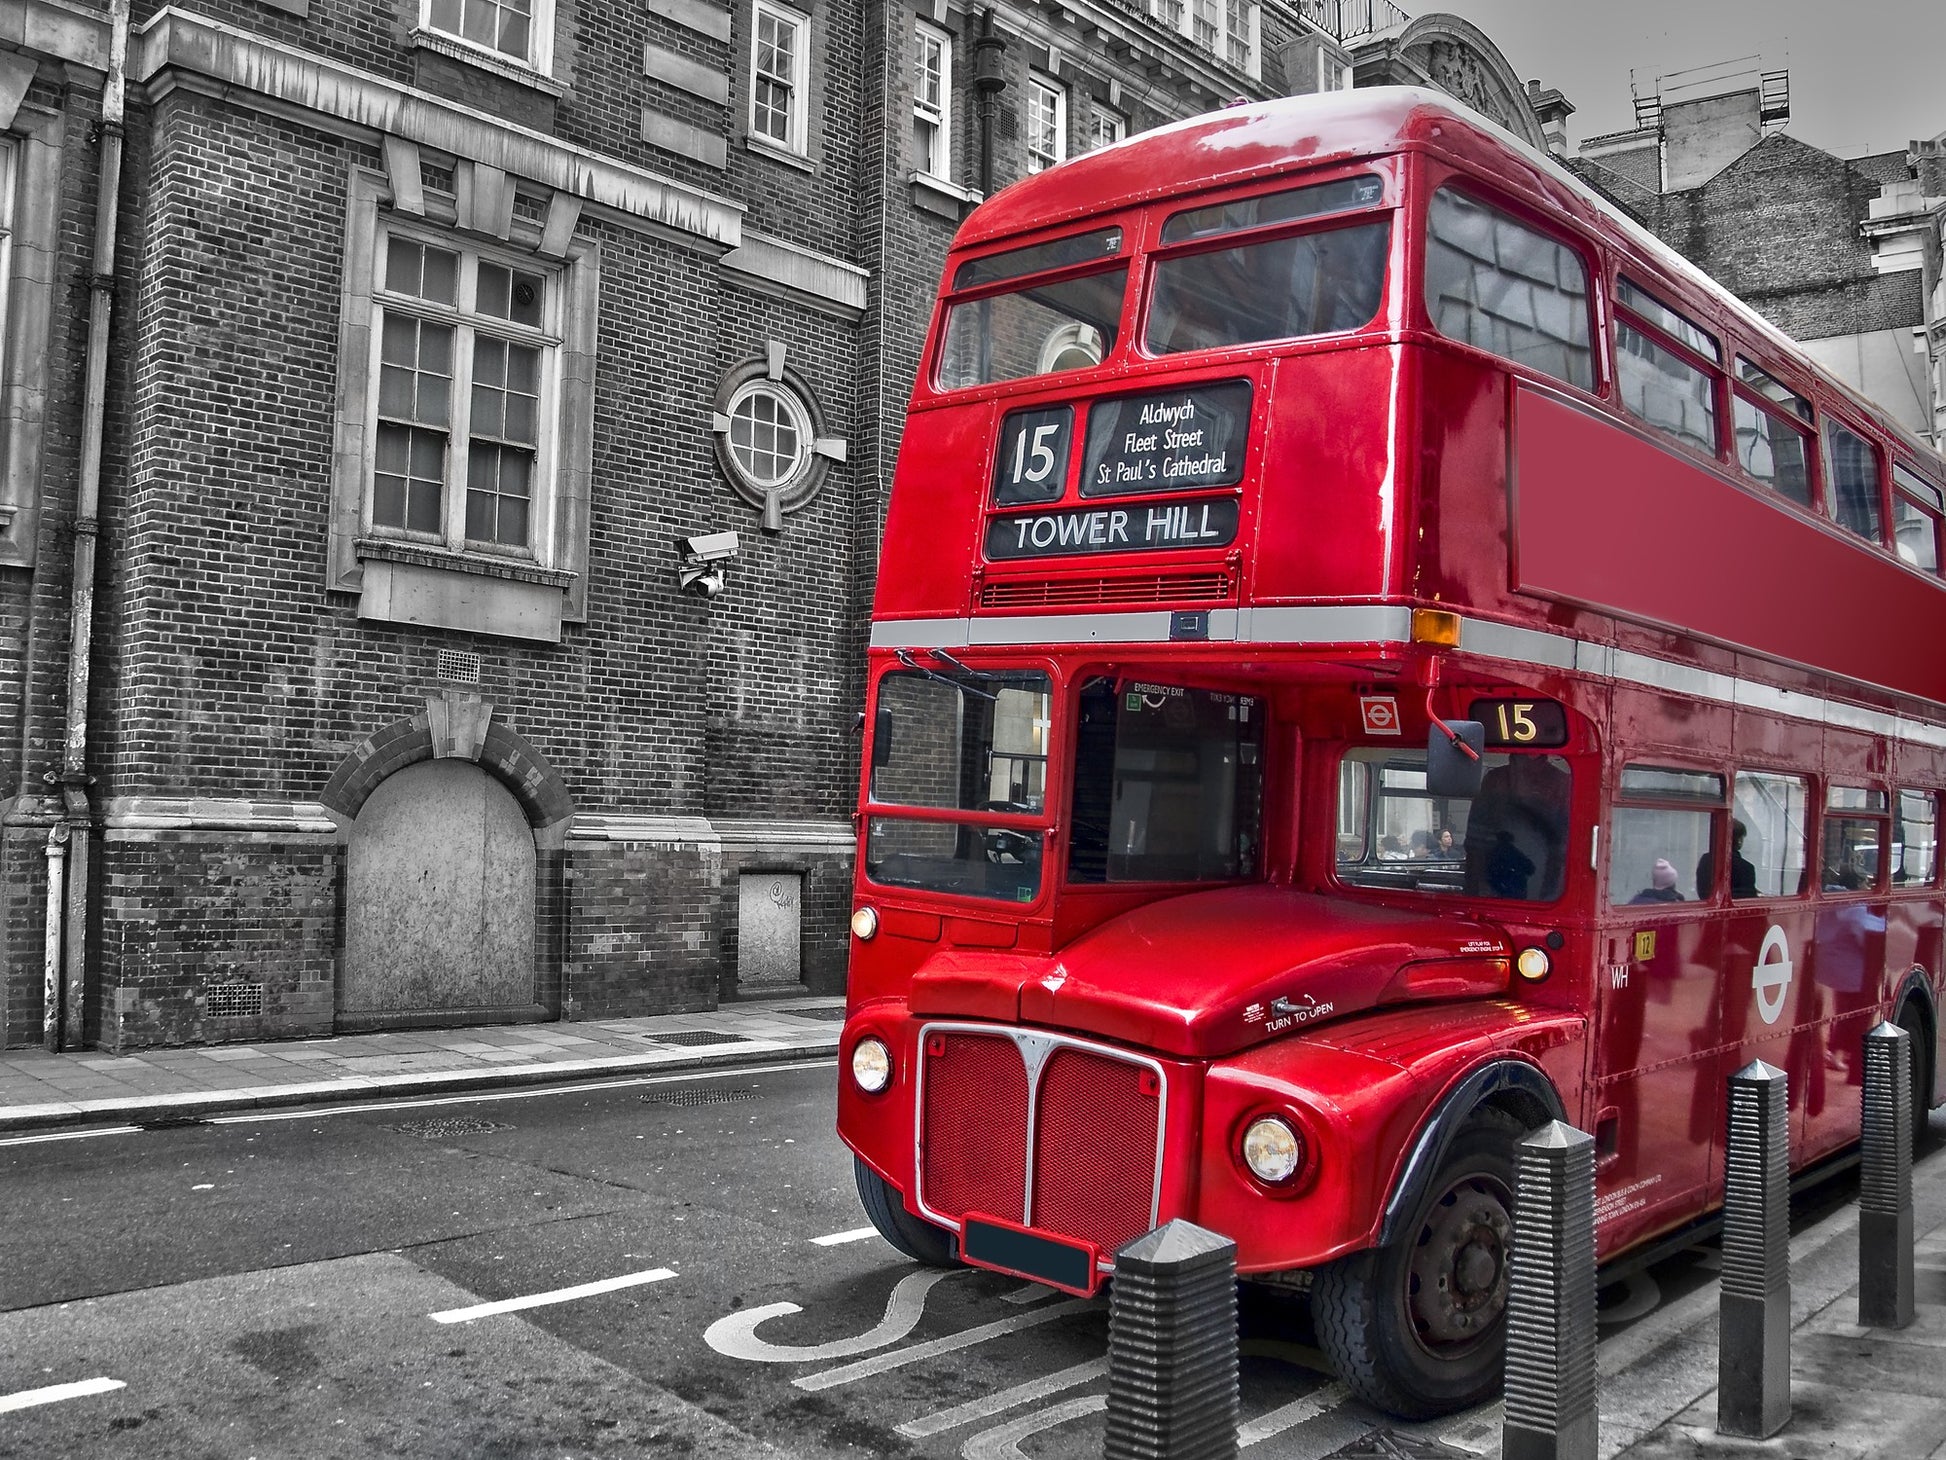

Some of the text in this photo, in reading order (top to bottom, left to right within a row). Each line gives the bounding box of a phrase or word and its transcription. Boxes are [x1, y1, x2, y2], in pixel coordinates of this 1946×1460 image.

[1139, 398, 1195, 427] Aldwych
[1012, 424, 1060, 484] 15
[1124, 428, 1203, 454] Fleet Street
[1097, 463, 1111, 485] St
[1163, 451, 1226, 477] Cathedral
[1014, 505, 1219, 549] TOWER HILL
[1134, 682, 1184, 697] EMERGENCY EXIT
[1498, 703, 1537, 742] 15
[1642, 936, 1650, 954] 12
[1611, 965, 1629, 990] WH
[1265, 1002, 1334, 1032] TURN TO OPEN
